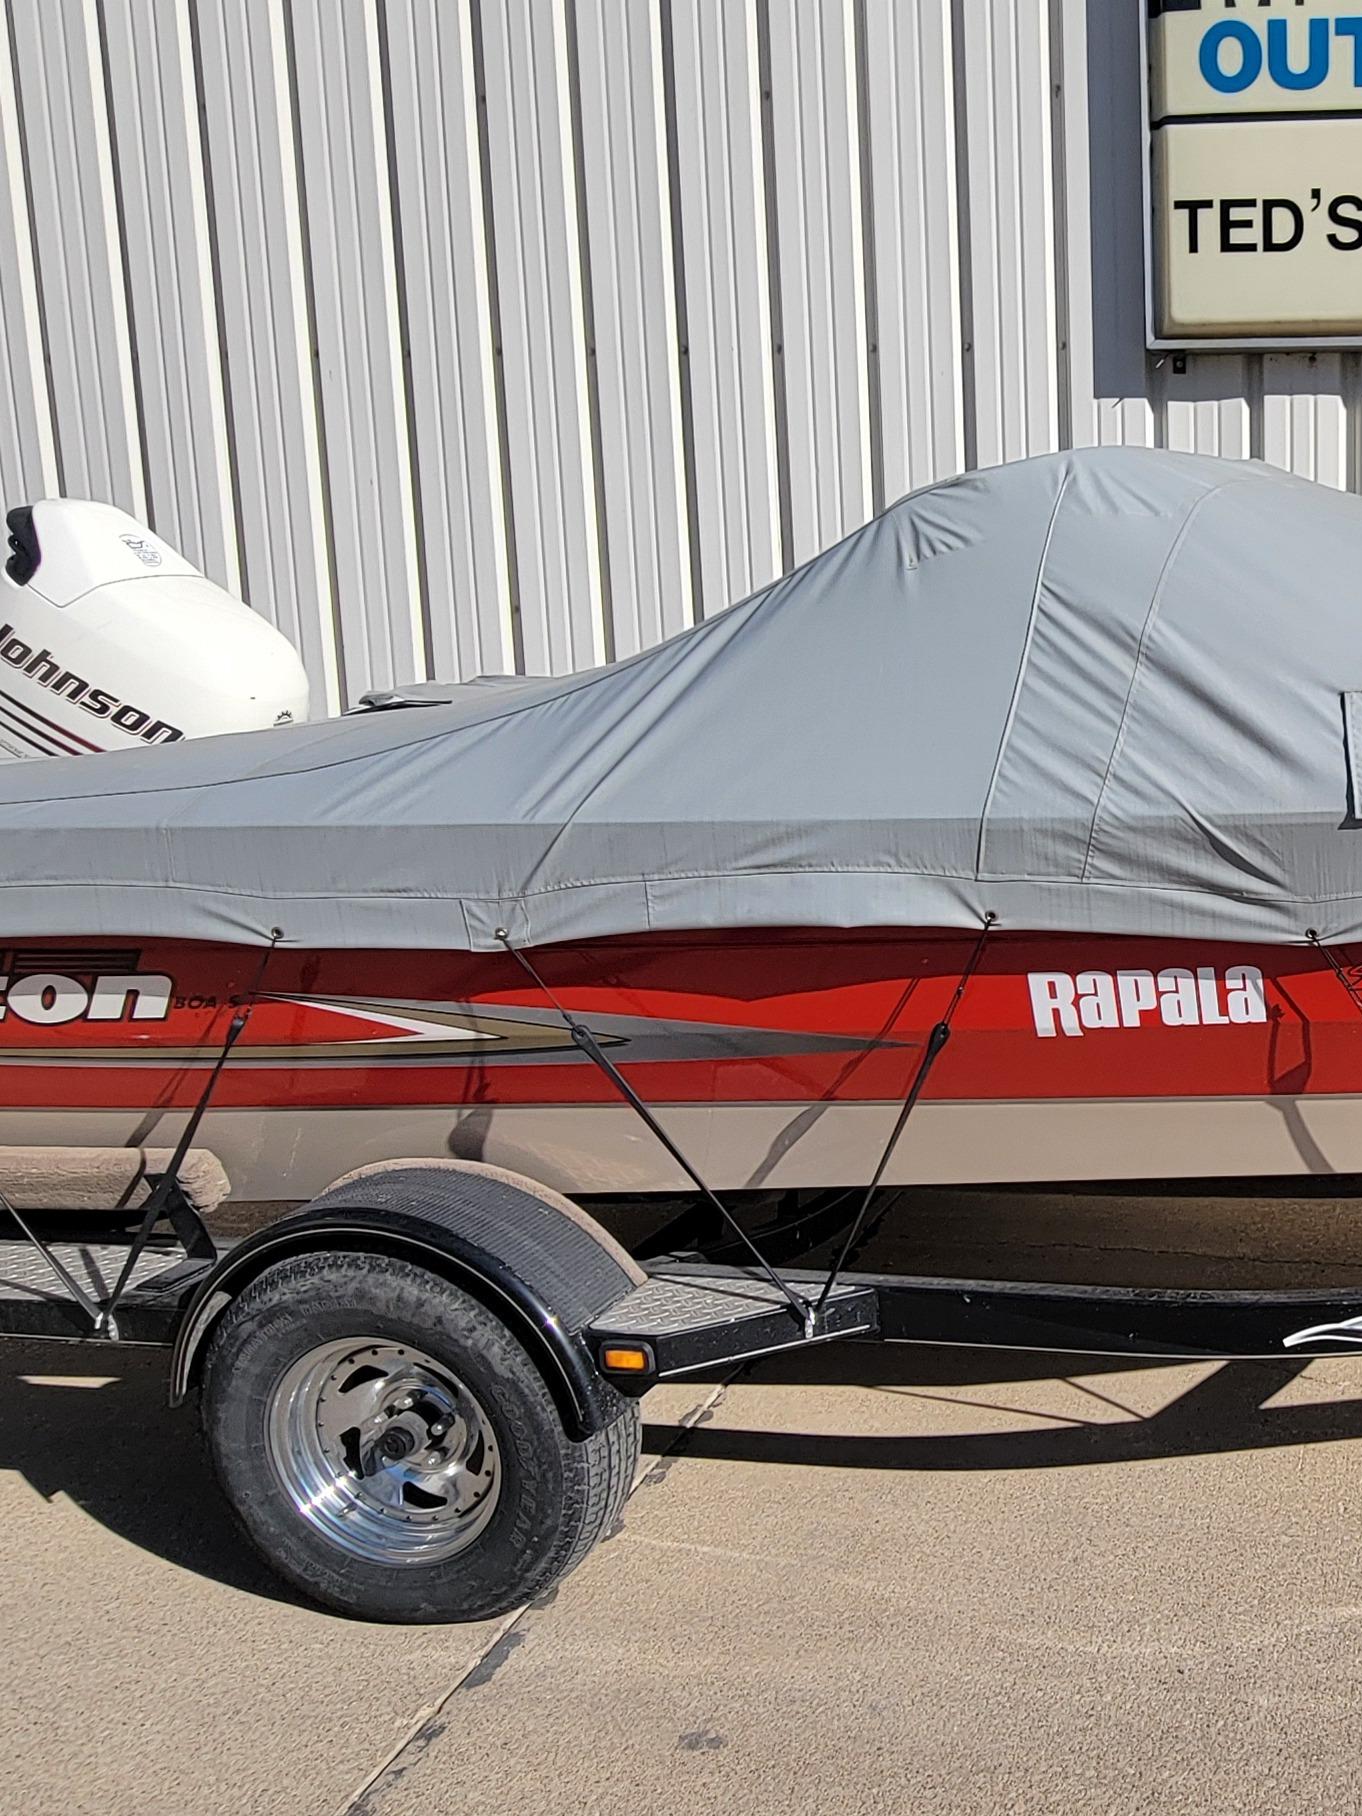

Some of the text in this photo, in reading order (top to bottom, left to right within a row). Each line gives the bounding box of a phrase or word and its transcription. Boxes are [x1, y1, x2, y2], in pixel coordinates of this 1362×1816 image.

[0, 972, 241, 1025] on BOAS
[490, 1384, 540, 1548] GOODYEAR
